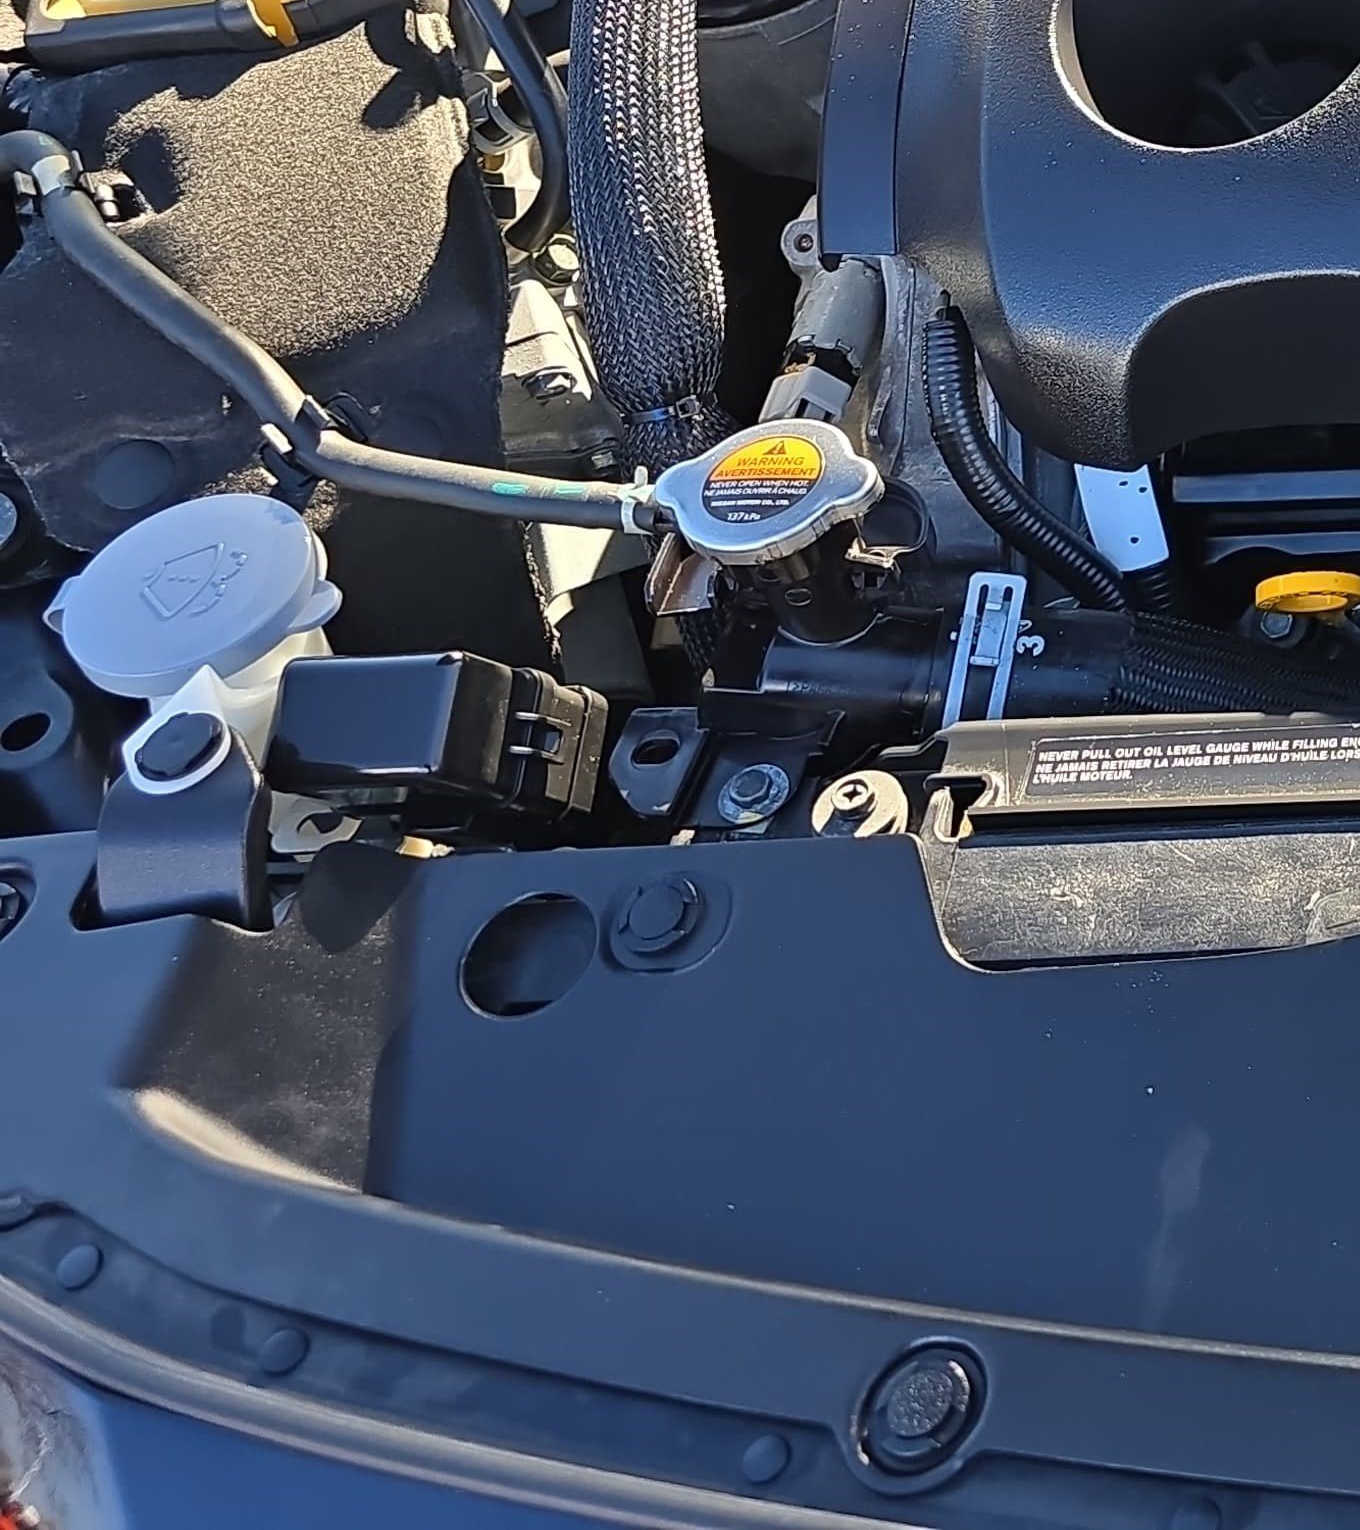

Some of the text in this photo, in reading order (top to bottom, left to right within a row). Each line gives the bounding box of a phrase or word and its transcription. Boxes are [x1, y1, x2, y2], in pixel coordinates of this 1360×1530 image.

[736, 456, 806, 467] WARNING
[715, 467, 817, 478] AVERTISSEMENT
[1037, 749, 1080, 762] NEVER
[1081, 748, 1113, 760] PULL
[1114, 746, 1142, 758] OUT
[1143, 745, 1164, 758] OIL
[1166, 743, 1203, 756] LEVEL
[1205, 741, 1250, 754] GAUGE
[1252, 738, 1290, 751] WHILE
[1292, 737, 1338, 750] FILLING
[1035, 762, 1052, 774] NE
[1054, 760, 1100, 773] JAMAIS
[1101, 758, 1151, 771] RETIRER
[1153, 756, 1170, 768] LA
[1171, 755, 1211, 768] JAUGE
[1213, 754, 1231, 766] DE
[1233, 752, 1278, 765] NIVEAU
[1032, 769, 1134, 784] L'HUILE MOTEUR.
